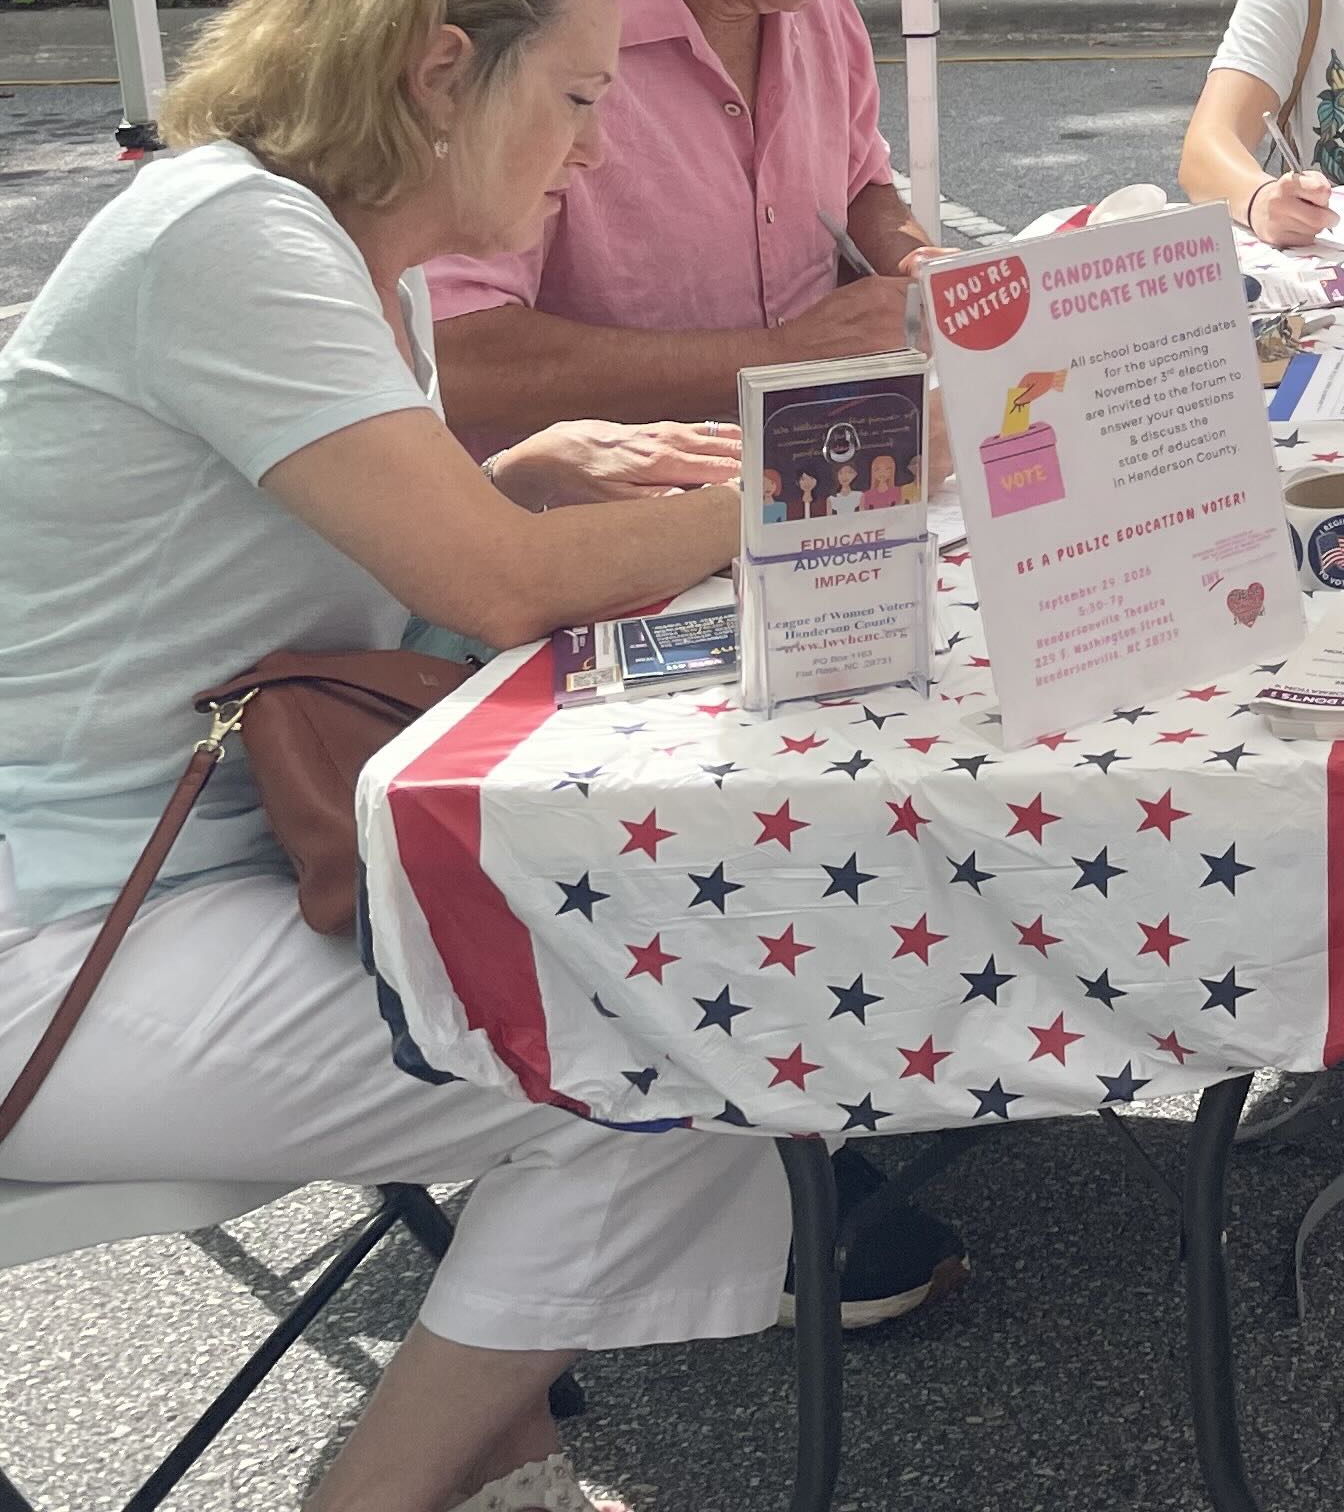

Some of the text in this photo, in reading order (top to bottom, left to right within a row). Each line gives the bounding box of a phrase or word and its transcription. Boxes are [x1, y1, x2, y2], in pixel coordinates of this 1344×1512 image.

[943, 258, 1013, 308] YOU'RE
[1041, 234, 1221, 292] CANDIDATE FORUM:
[943, 276, 1031, 336] INVITED!
[1049, 262, 1223, 320] EDUCATE THE VOTE!
[1070, 319, 1238, 369] All school board candidates
[1104, 344, 1210, 379] for the upcoming
[1085, 370, 1242, 422] are invited to the forum to
[1094, 375, 1158, 400] November
[1178, 358, 1227, 378] election
[1001, 465, 1047, 494] VOTE
[800, 527, 887, 553] EDUCATE
[1016, 490, 1247, 576] BE A PUBLIC EDUCATION VOTER!
[793, 546, 893, 573] ADVOCATE
[813, 567, 882, 590] IMPACT
